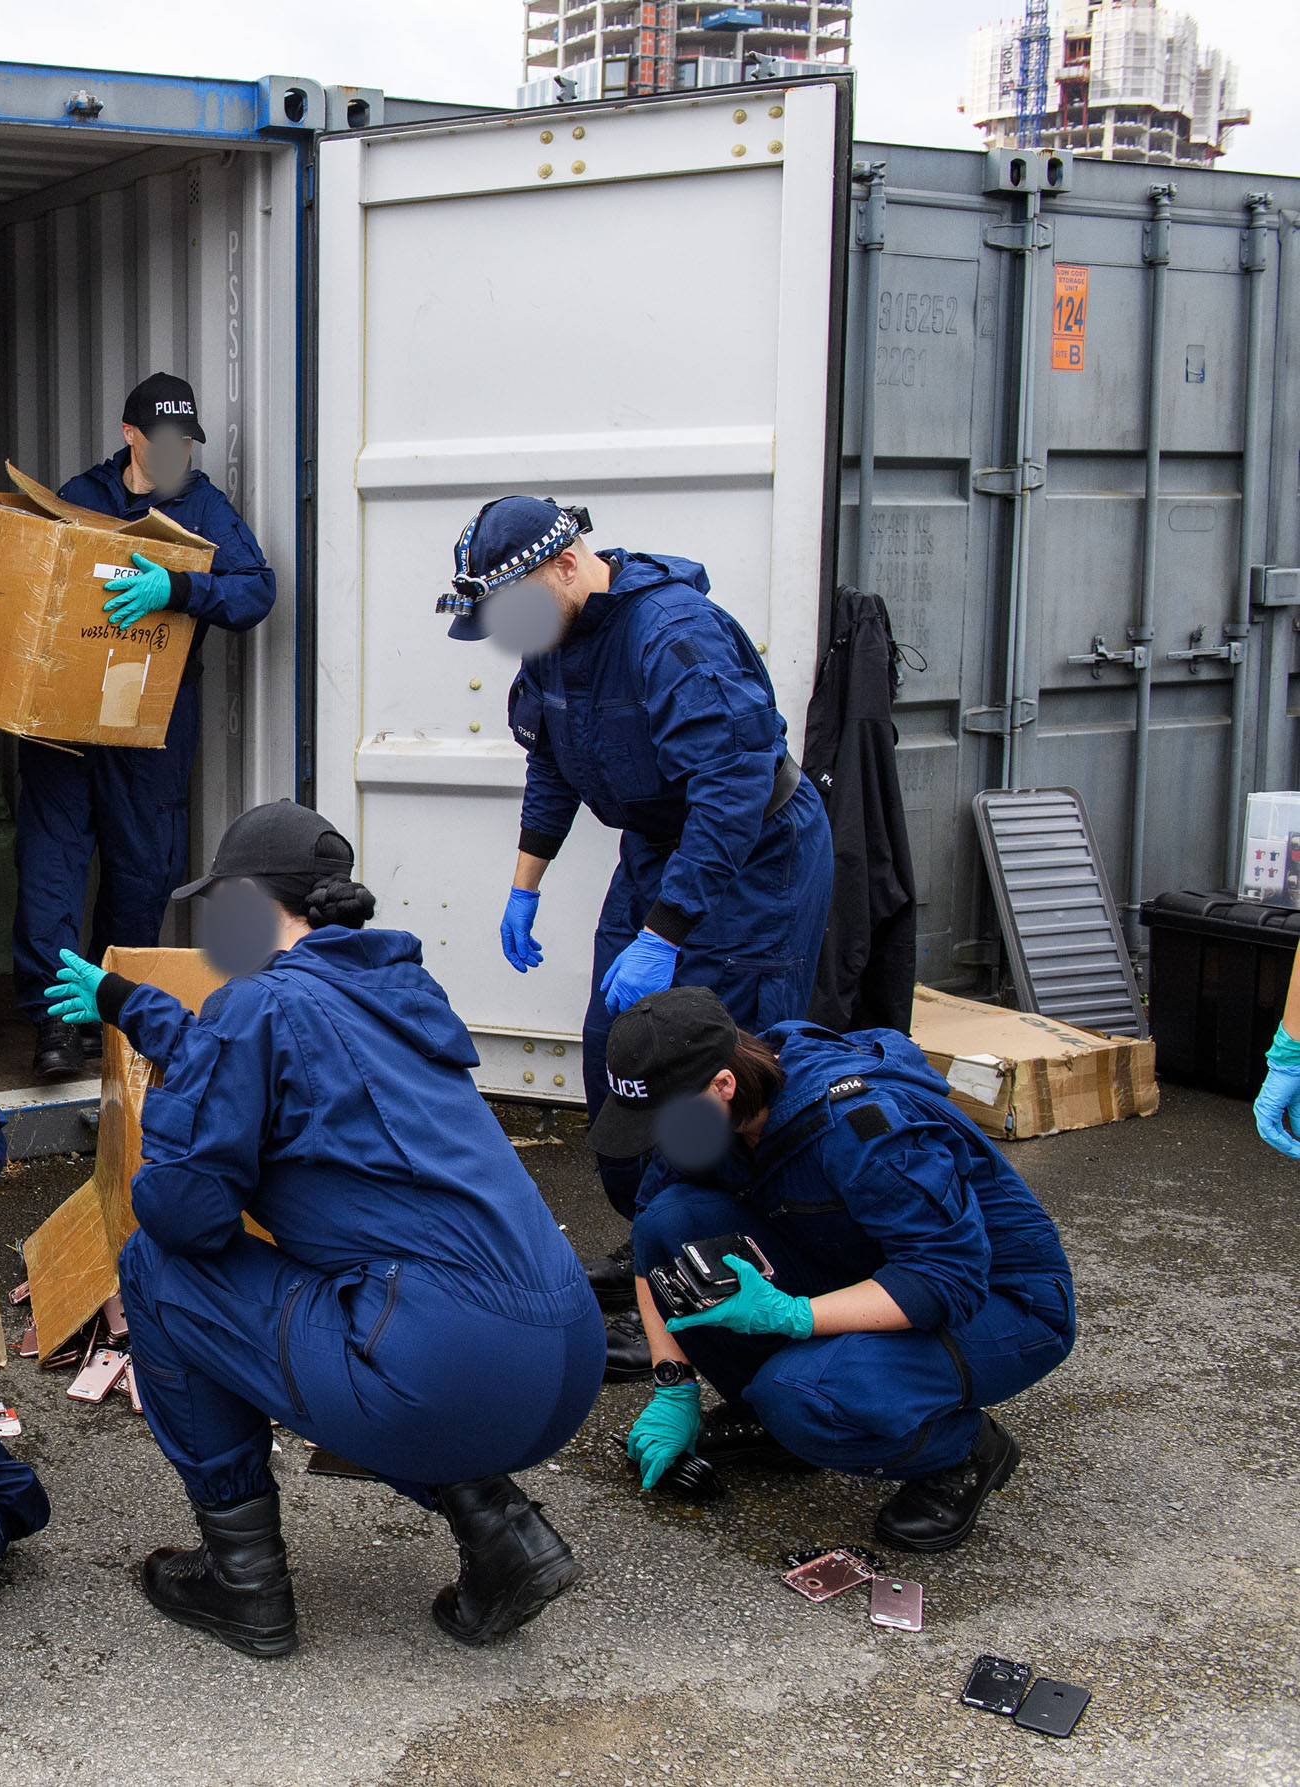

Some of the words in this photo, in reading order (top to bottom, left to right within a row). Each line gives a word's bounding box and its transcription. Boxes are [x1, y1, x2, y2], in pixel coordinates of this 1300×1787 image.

[228, 231, 238, 402] PSSU
[879, 291, 958, 334] 315252
[1056, 296, 1084, 333] 124
[1069, 344, 1081, 365] B
[155, 400, 194, 416] POLICE
[830, 1079, 862, 1094] 17914
